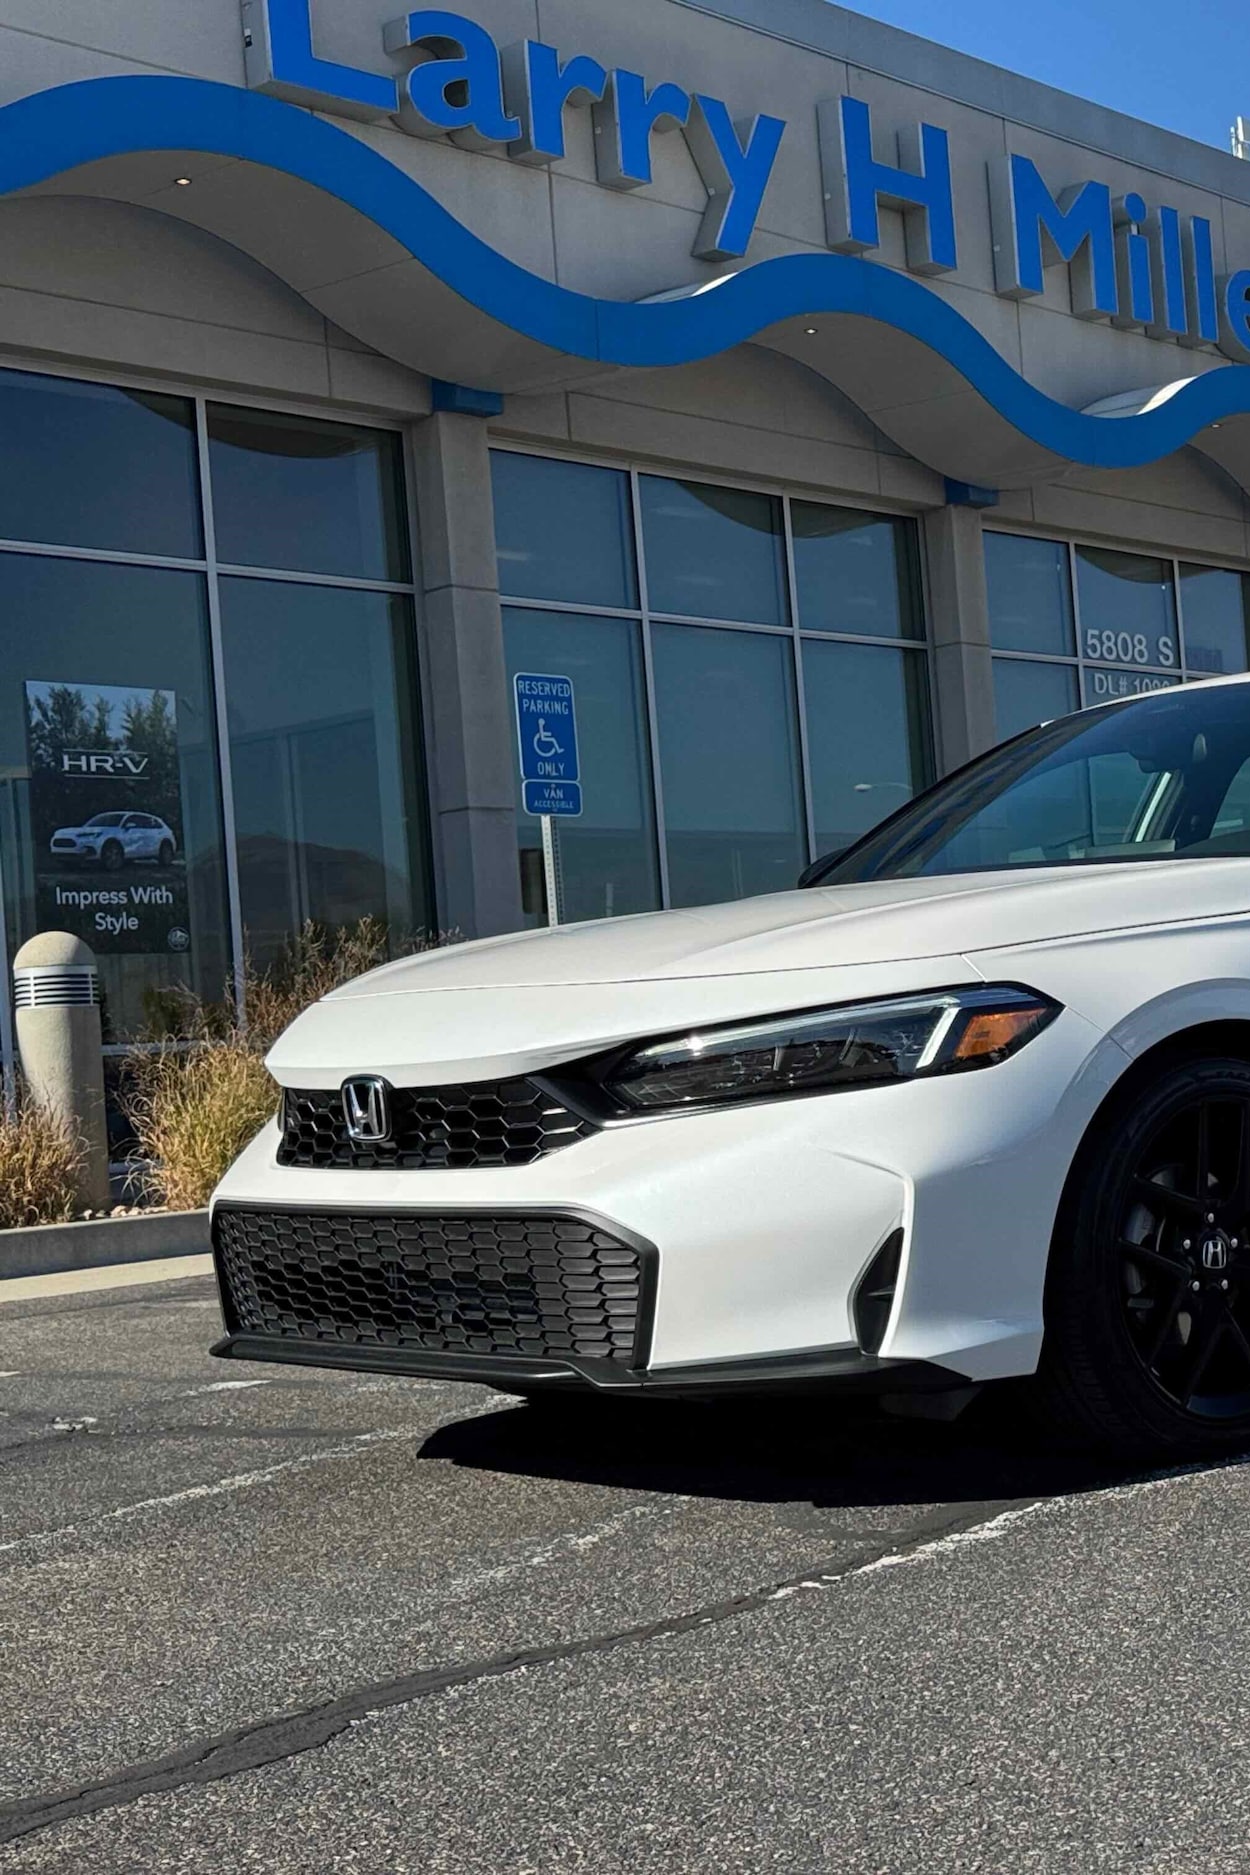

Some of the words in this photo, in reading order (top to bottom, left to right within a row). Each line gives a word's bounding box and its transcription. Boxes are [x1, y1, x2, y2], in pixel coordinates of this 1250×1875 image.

[836, 95, 957, 272] H
[1086, 628, 1149, 664] 5808
[1157, 636, 1175, 666] S
[517, 679, 571, 698] RESERVED
[1094, 672, 1129, 696] DL#
[522, 698, 569, 715] PARKING
[62, 754, 149, 774] HR-V
[537, 761, 565, 777] ONLY
[543, 786, 564, 800] VAN
[55, 886, 128, 909] Impress
[131, 886, 173, 905] With
[94, 912, 139, 936] Style
